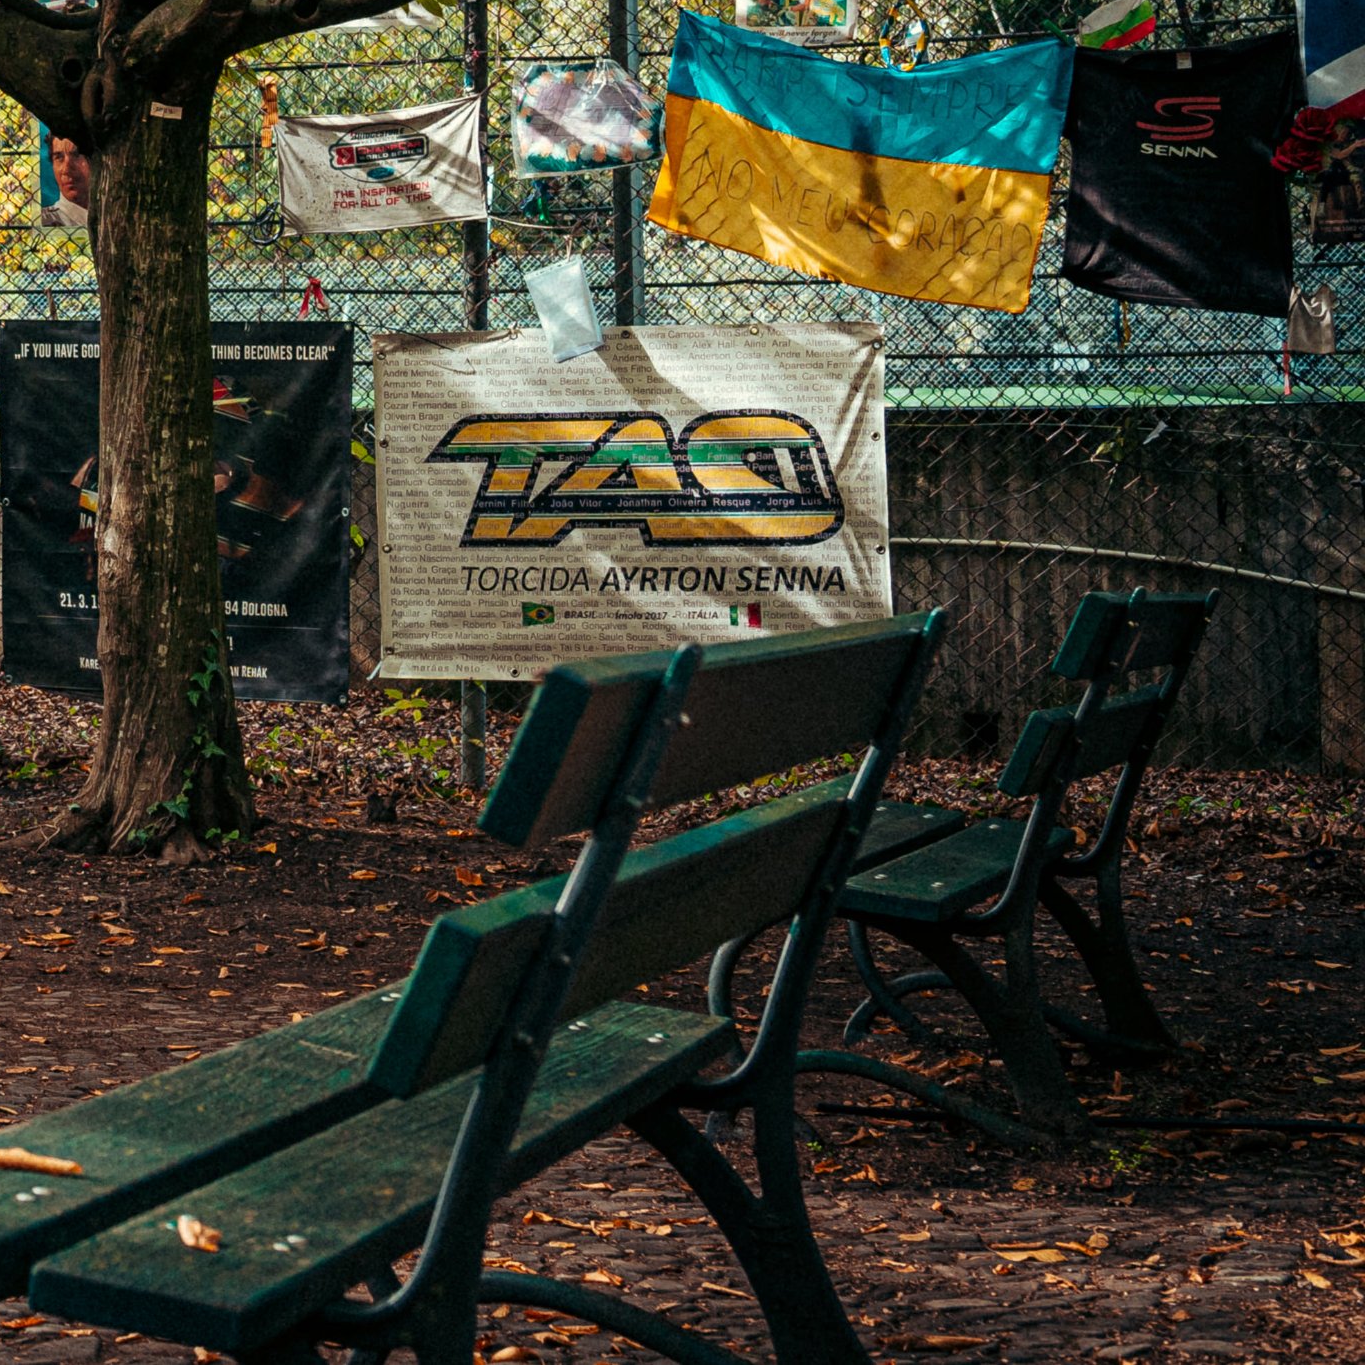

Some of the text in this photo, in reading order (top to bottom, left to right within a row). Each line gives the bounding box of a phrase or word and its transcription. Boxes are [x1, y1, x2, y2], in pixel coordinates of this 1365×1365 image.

[1140, 142, 1218, 159] SENNA
[334, 181, 429, 199] THE INSPIRATION
[696, 149, 754, 201] NO
[772, 178, 849, 233] MEU
[333, 192, 432, 209] FOR ALL OF THIS
[669, 330, 704, 339] Campos
[33, 343, 52, 359] YOU
[54, 343, 78, 359] HAVE
[81, 343, 100, 359] GOD
[211, 344, 240, 360] THING
[244, 345, 293, 361] BECOMES
[411, 390, 444, 398] Mendes
[565, 388, 595, 396] Santos
[617, 498, 662, 507] Jonathan
[668, 498, 706, 506] Oliveira
[767, 497, 794, 507] Jorge
[461, 565, 846, 592] TORCIDA AYRTON SENNA
[224, 600, 239, 616] 94
[241, 600, 289, 617] BOLOGNA
[564, 610, 595, 620] BRASIL
[645, 611, 668, 620] 2017
